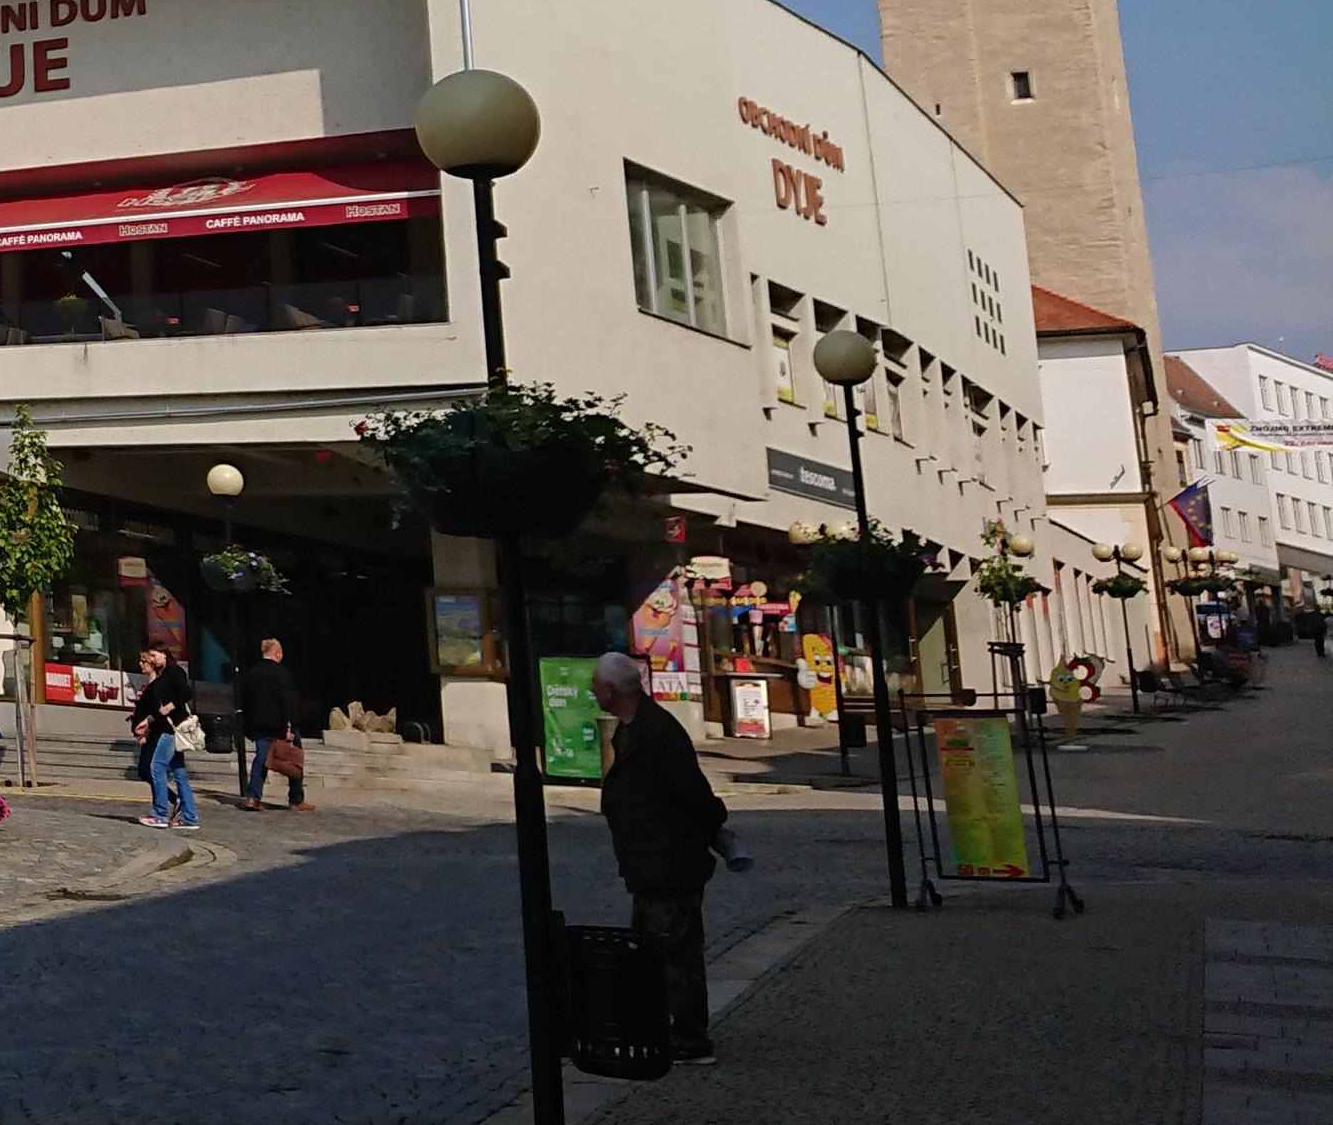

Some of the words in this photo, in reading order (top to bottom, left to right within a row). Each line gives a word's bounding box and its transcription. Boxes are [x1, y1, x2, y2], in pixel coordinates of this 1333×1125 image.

[346, 203, 400, 218] HOSTAN
[206, 215, 241, 228] CAFFÉ
[242, 212, 305, 225] PANORAMA
[119, 223, 168, 236] HOSTAN
[27, 231, 82, 244] PANORAMA
